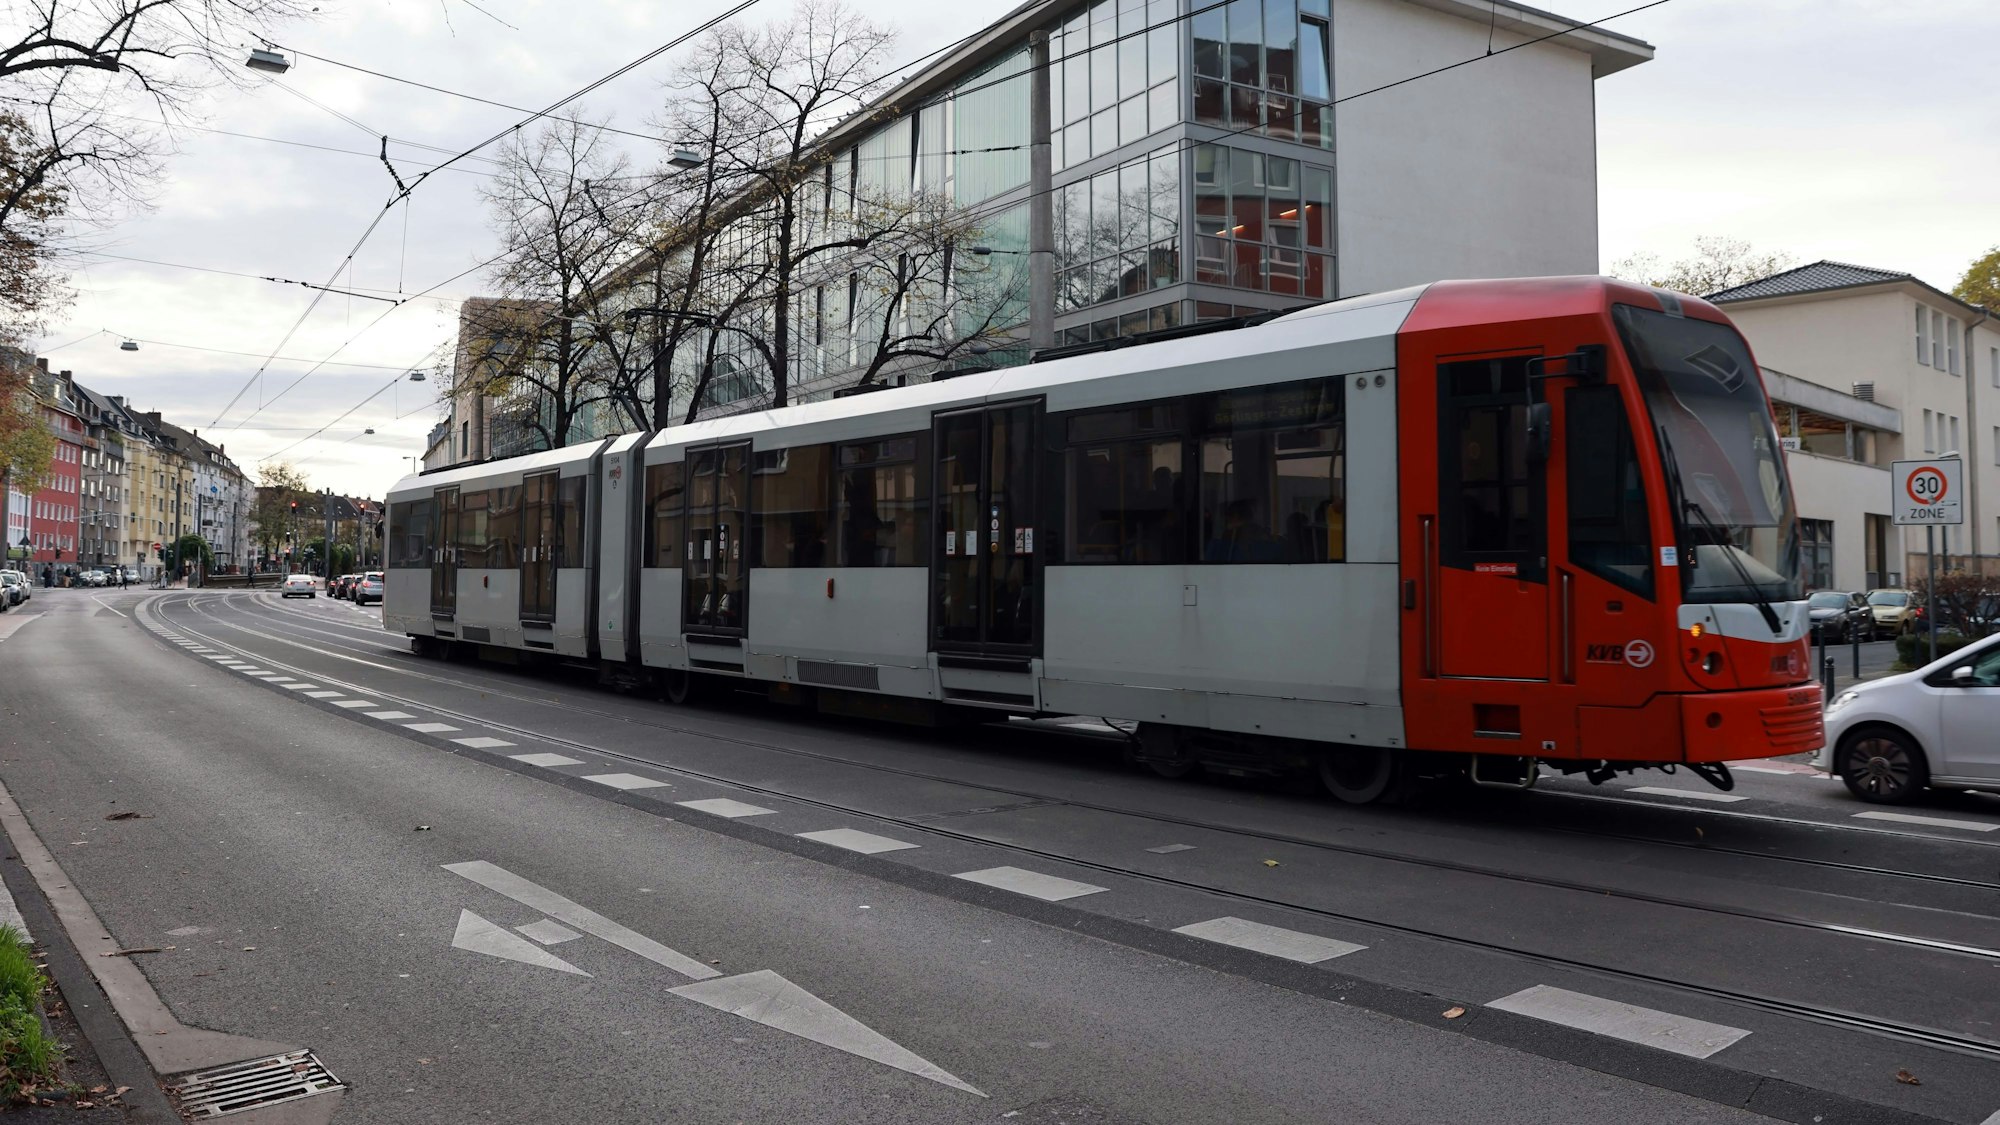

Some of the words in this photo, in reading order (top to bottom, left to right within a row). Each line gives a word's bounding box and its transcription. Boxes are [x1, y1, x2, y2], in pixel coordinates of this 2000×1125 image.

[1915, 476, 1939, 494] 30
[1910, 508, 1945, 519] ZONE
[1586, 644, 1623, 661] KVB
